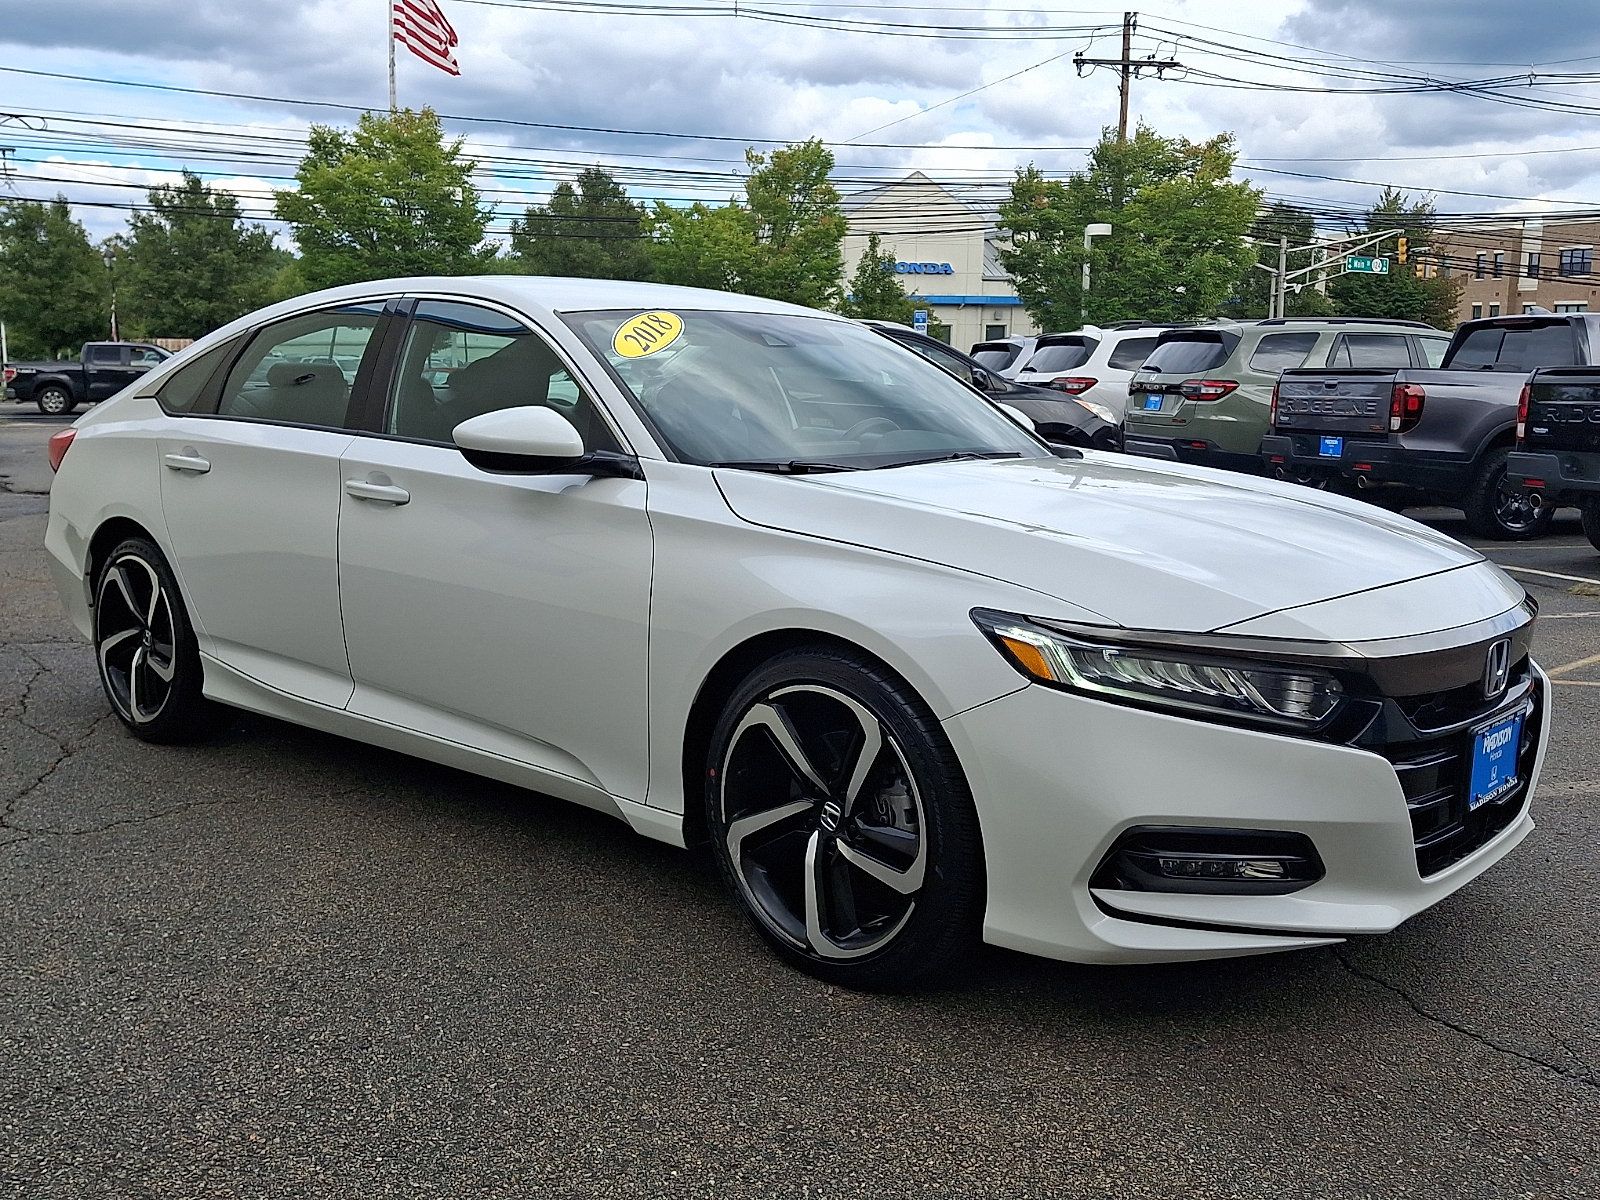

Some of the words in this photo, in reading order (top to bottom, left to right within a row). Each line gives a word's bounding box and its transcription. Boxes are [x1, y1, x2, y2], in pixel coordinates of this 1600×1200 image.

[623, 314, 673, 353] 2018
[1482, 725, 1513, 755] MADISON
[1469, 790, 1498, 812] MADISON
